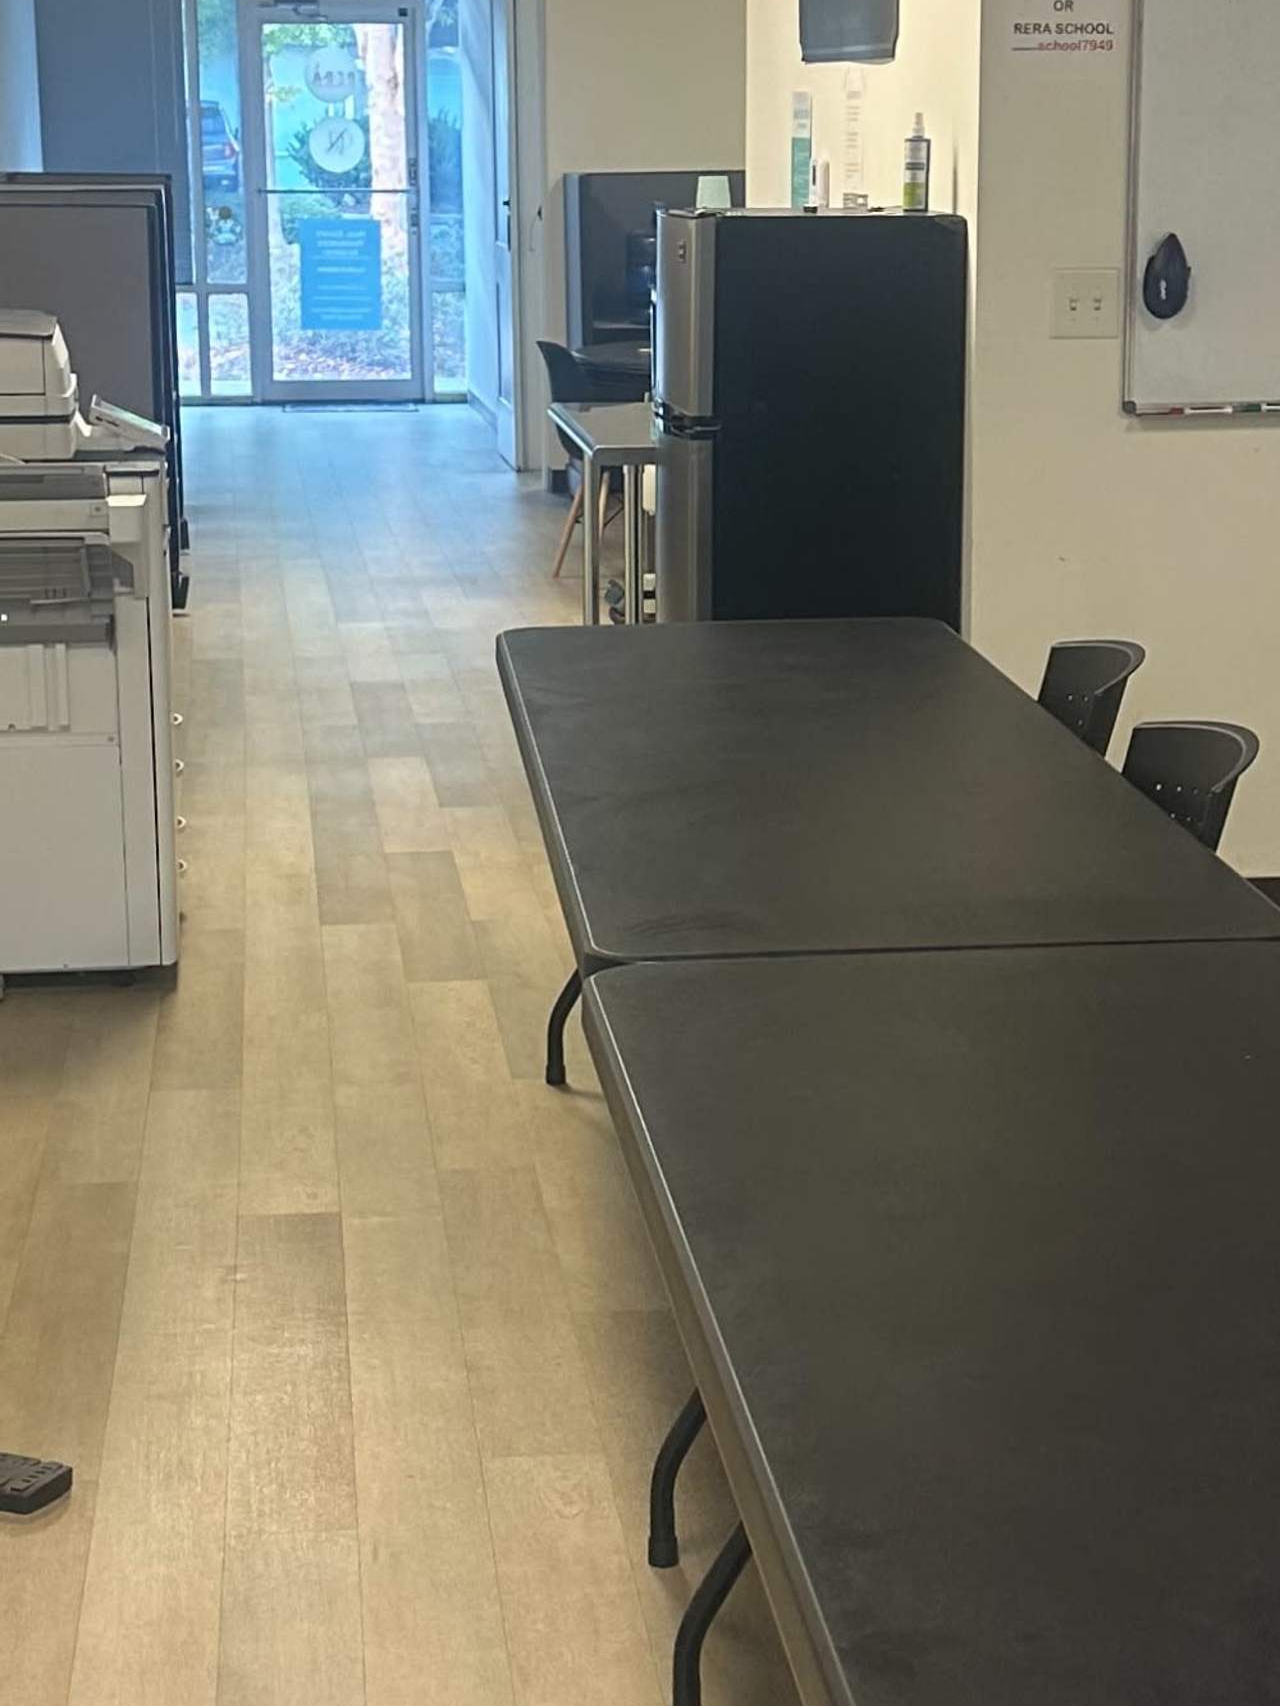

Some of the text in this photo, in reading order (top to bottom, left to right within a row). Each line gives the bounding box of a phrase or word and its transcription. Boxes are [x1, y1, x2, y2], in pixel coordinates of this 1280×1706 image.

[1053, 0, 1074, 11] OR
[1014, 22, 1114, 34] RERA SCHOOL
